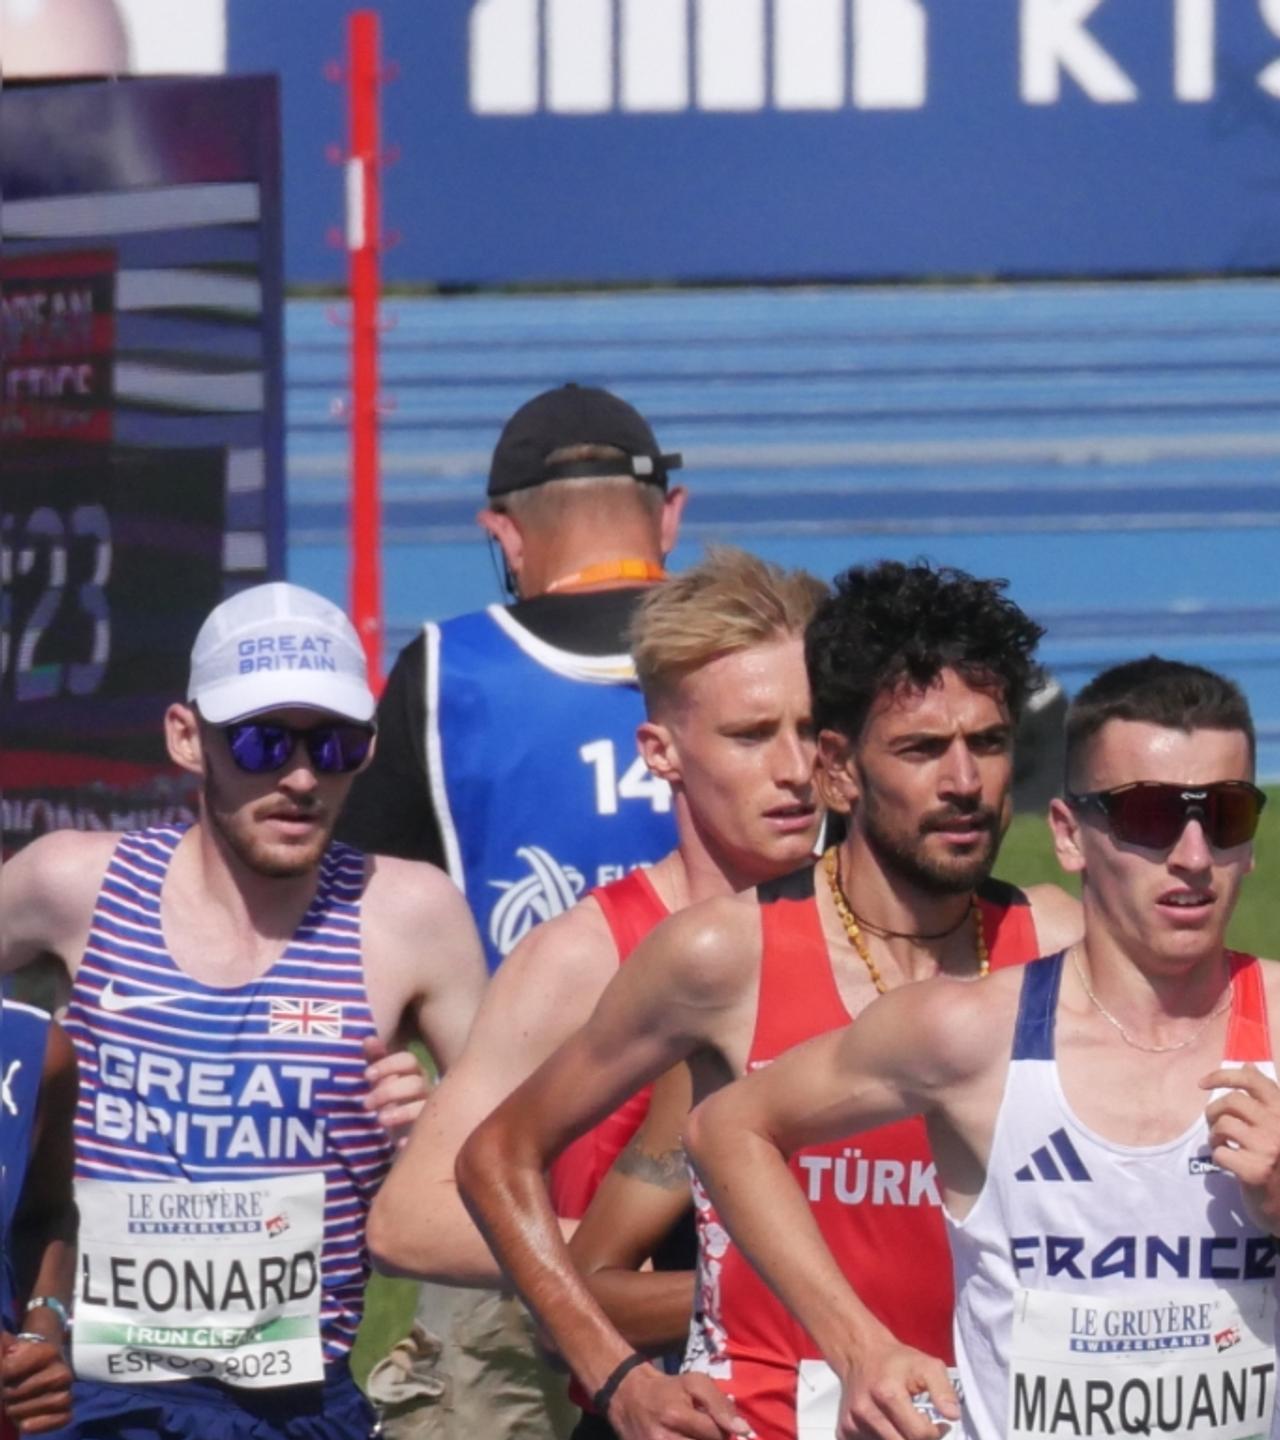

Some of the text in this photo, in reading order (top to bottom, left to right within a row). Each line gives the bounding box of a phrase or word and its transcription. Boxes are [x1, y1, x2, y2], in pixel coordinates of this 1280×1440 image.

[238, 635, 332, 657] GREAT
[238, 652, 337, 675] BRITAIN
[579, 738, 673, 815] 14
[99, 1043, 330, 1109] GREAT
[96, 1092, 326, 1159] BRITAIN
[799, 1147, 943, 1206] TÜRK
[128, 1188, 264, 1221] LE GRUYÈRE
[1009, 1235, 1276, 1280] FRANCE
[82, 1251, 318, 1313] LEONARD
[137, 1327, 188, 1346] RUN
[1070, 1300, 1212, 1337] LE GRUYÈRE
[1074, 1336, 1205, 1351] SWITZERLAND
[224, 1350, 292, 1380] 2023
[1013, 1363, 1275, 1437] MARQUANT
